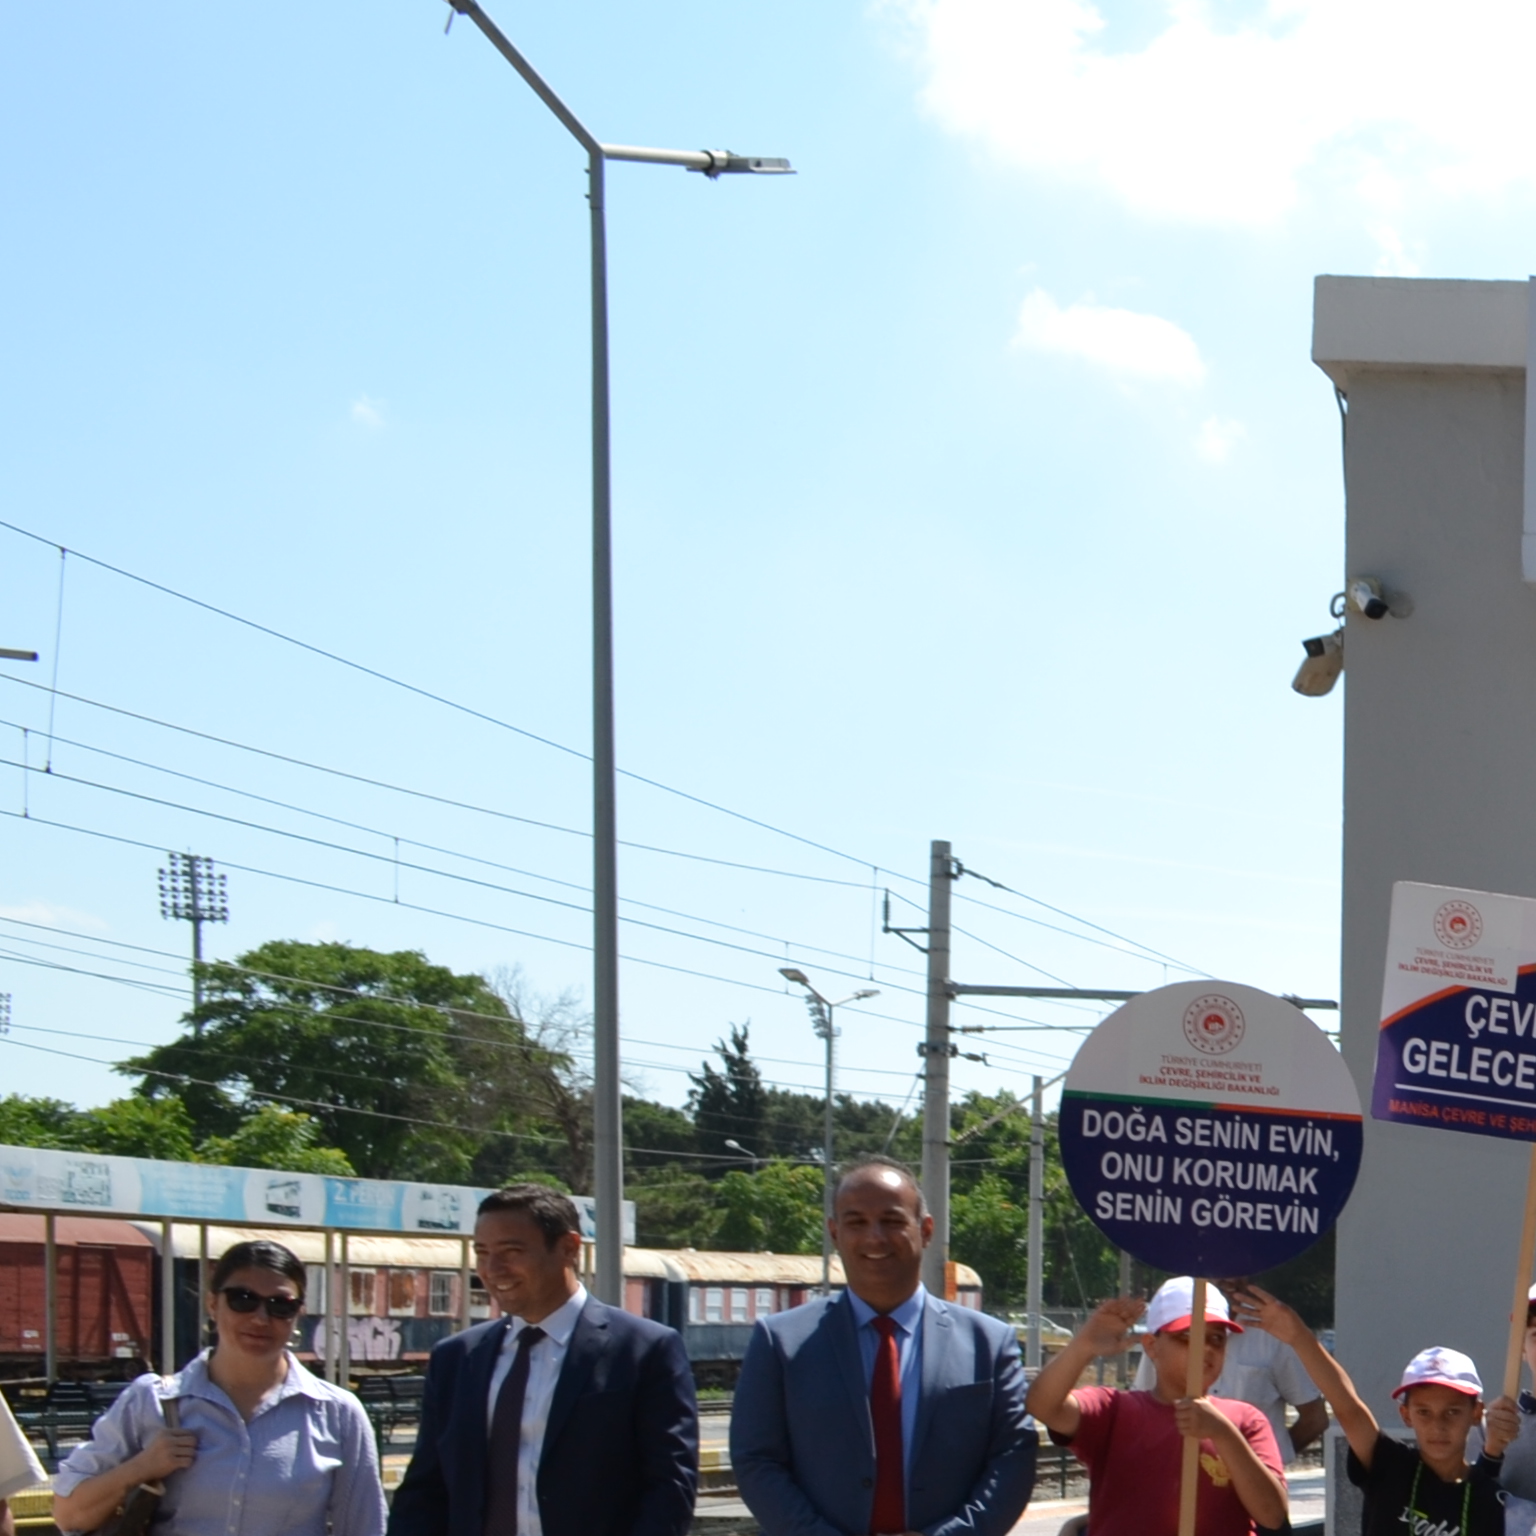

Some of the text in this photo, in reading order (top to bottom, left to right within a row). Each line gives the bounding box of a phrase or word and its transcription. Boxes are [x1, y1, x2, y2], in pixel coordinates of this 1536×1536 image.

[1160, 1066, 1261, 1083] ÇEVRE, ŞEHİRCİLİK VE
[1161, 1055, 1198, 1066] TÜRKİYE
[1139, 1074, 1279, 1096] İKLİM DEĞİŞİKLİĞİ BAKANLIĞI
[1389, 1099, 1439, 1119] MANİSA
[1442, 1106, 1485, 1125] ÇEVRE
[1491, 1112, 1506, 1127] VE
[1081, 1106, 1339, 1162] DOĞA SENİN EVİN,
[1100, 1151, 1319, 1194] ONU KORUMAK
[1095, 1189, 1319, 1234] SENİN GÖREVİN
